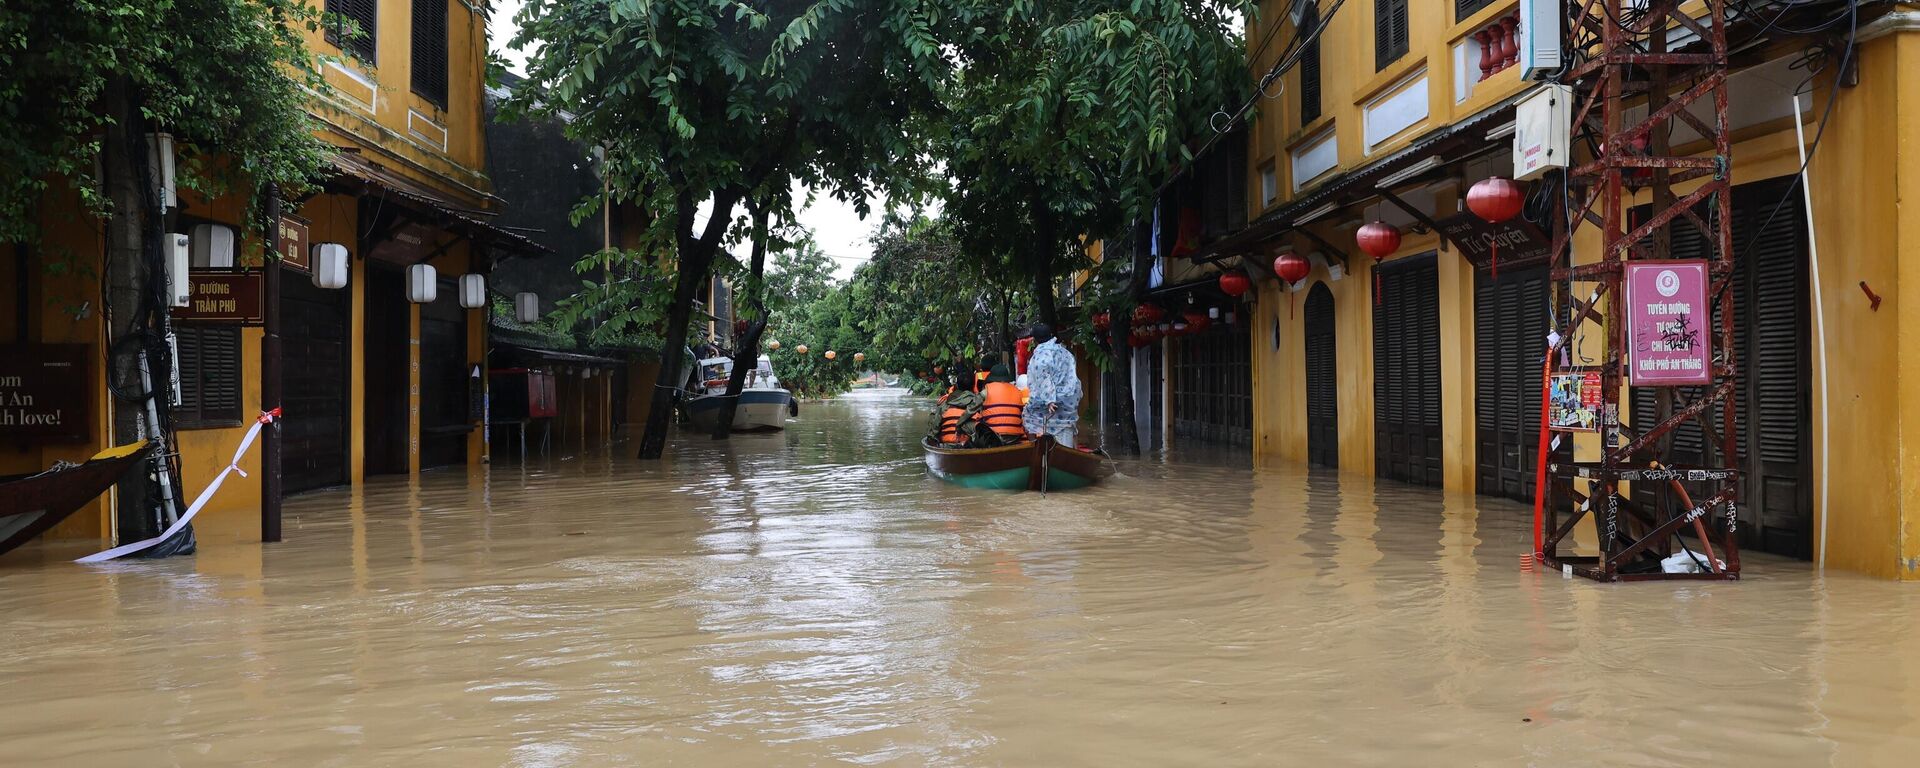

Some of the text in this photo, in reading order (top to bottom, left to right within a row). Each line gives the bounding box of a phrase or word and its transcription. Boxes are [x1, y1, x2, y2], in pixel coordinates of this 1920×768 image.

[200, 281, 230, 295] ĐƯỜNG
[195, 296, 236, 313] TRẦN PHÚ
[9, 391, 33, 406] An
[20, 409, 61, 425] love!
